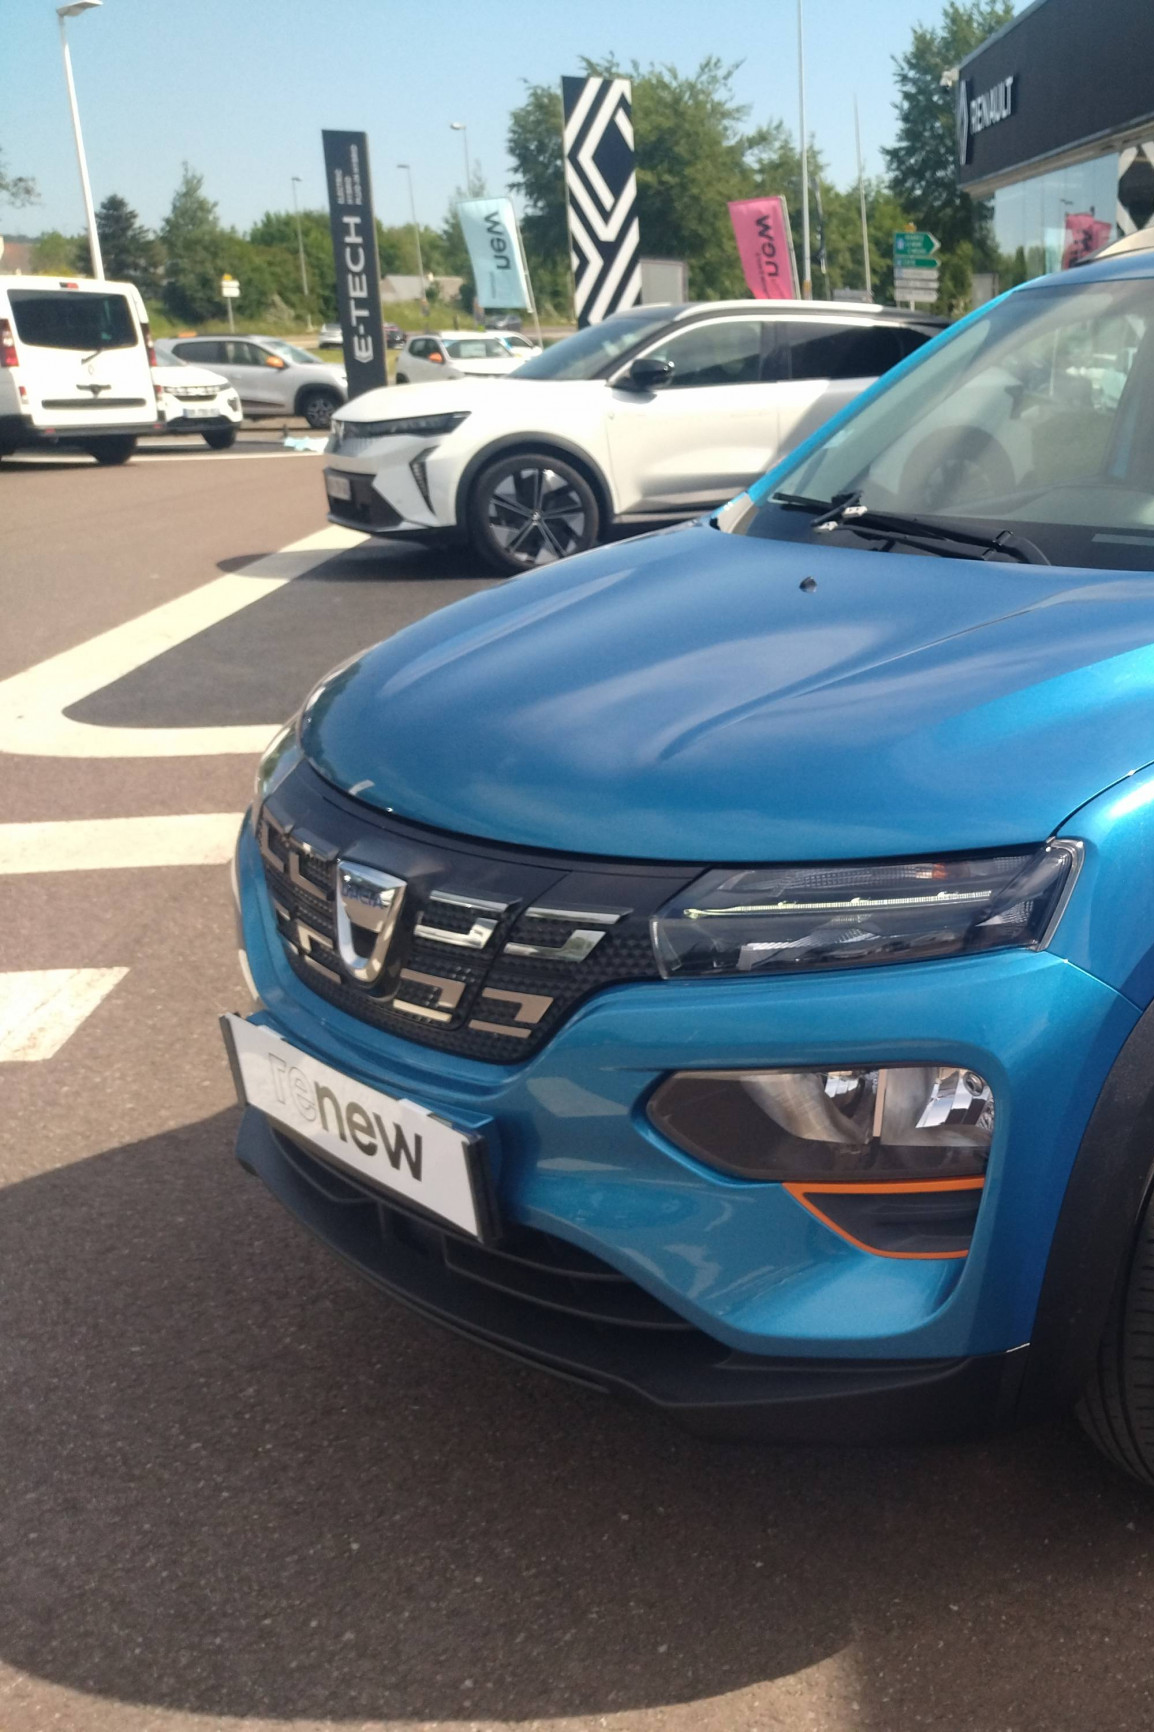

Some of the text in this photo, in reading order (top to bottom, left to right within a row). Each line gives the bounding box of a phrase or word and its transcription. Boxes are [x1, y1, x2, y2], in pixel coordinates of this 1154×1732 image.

[970, 76, 1014, 135] RENAULT
[342, 216, 374, 363] E-TECH
[268, 1052, 423, 1183] renew
